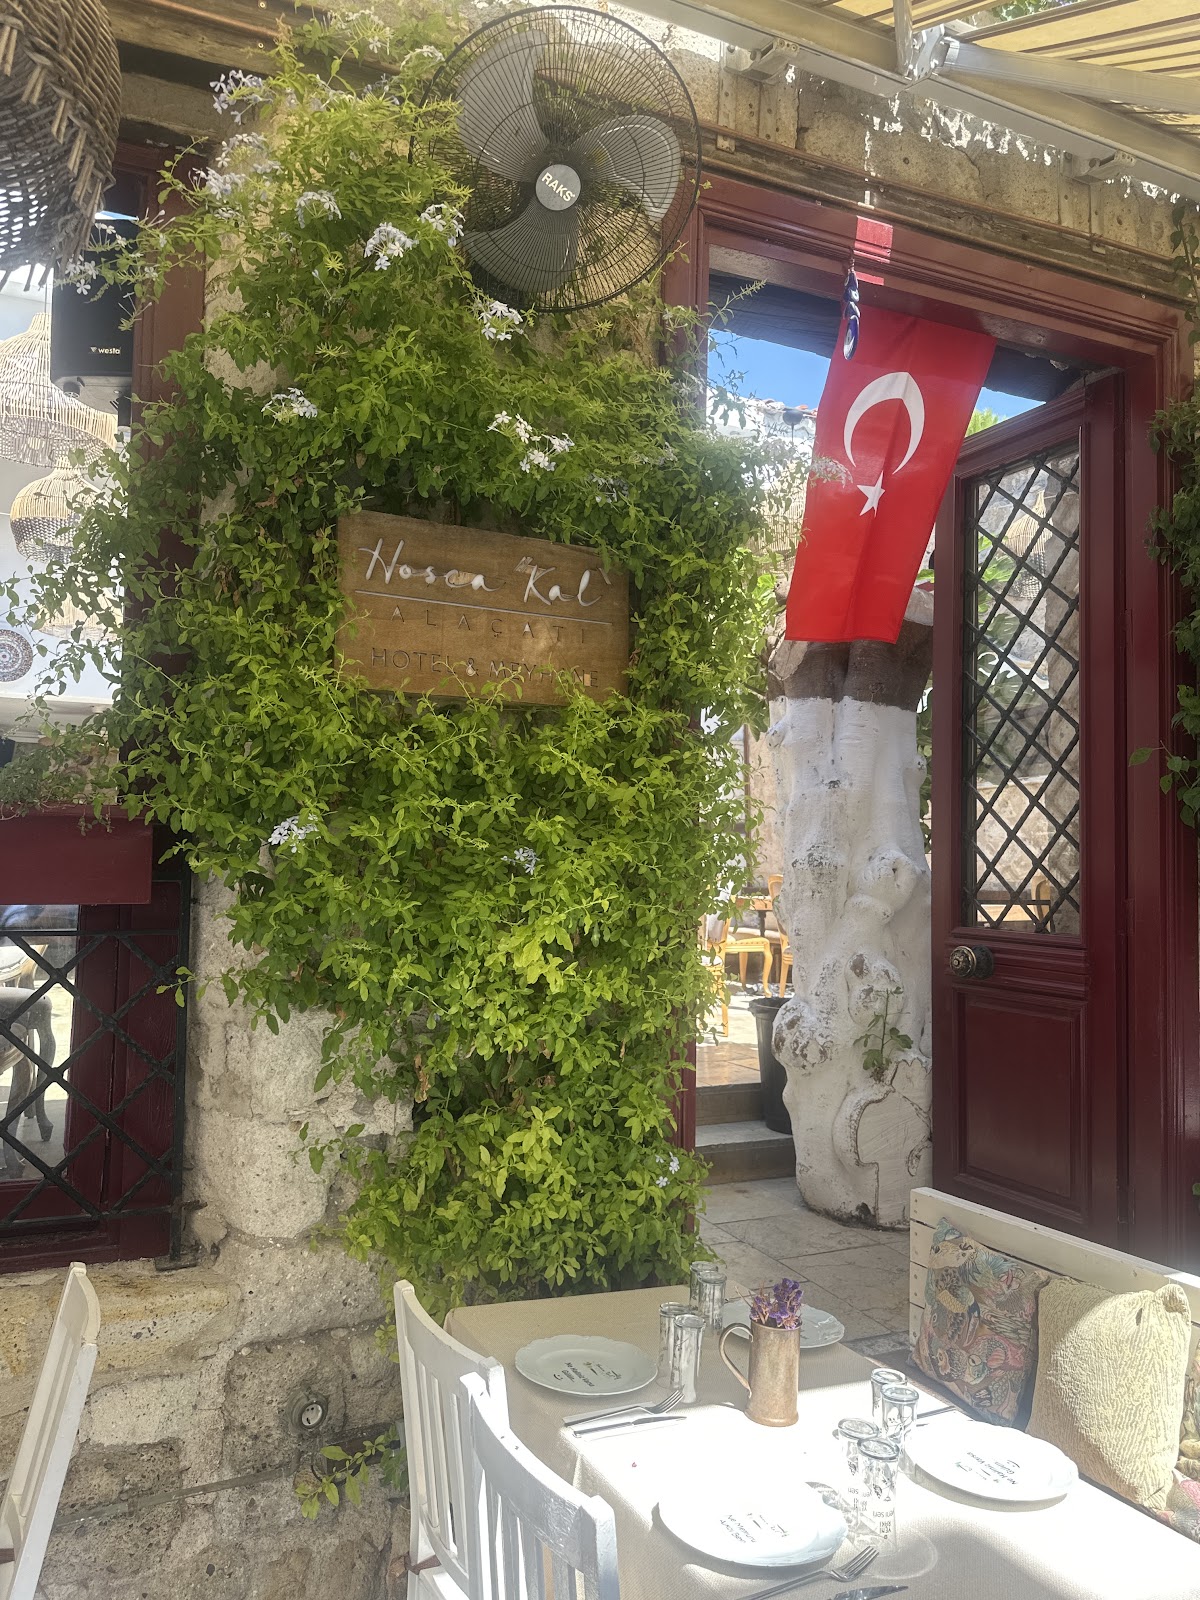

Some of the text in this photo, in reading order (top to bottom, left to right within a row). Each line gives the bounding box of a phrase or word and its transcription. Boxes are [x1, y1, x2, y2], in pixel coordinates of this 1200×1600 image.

[541, 172, 573, 202] RAKS
[371, 647, 456, 674] HOTEL
[466, 657, 479, 677] &
